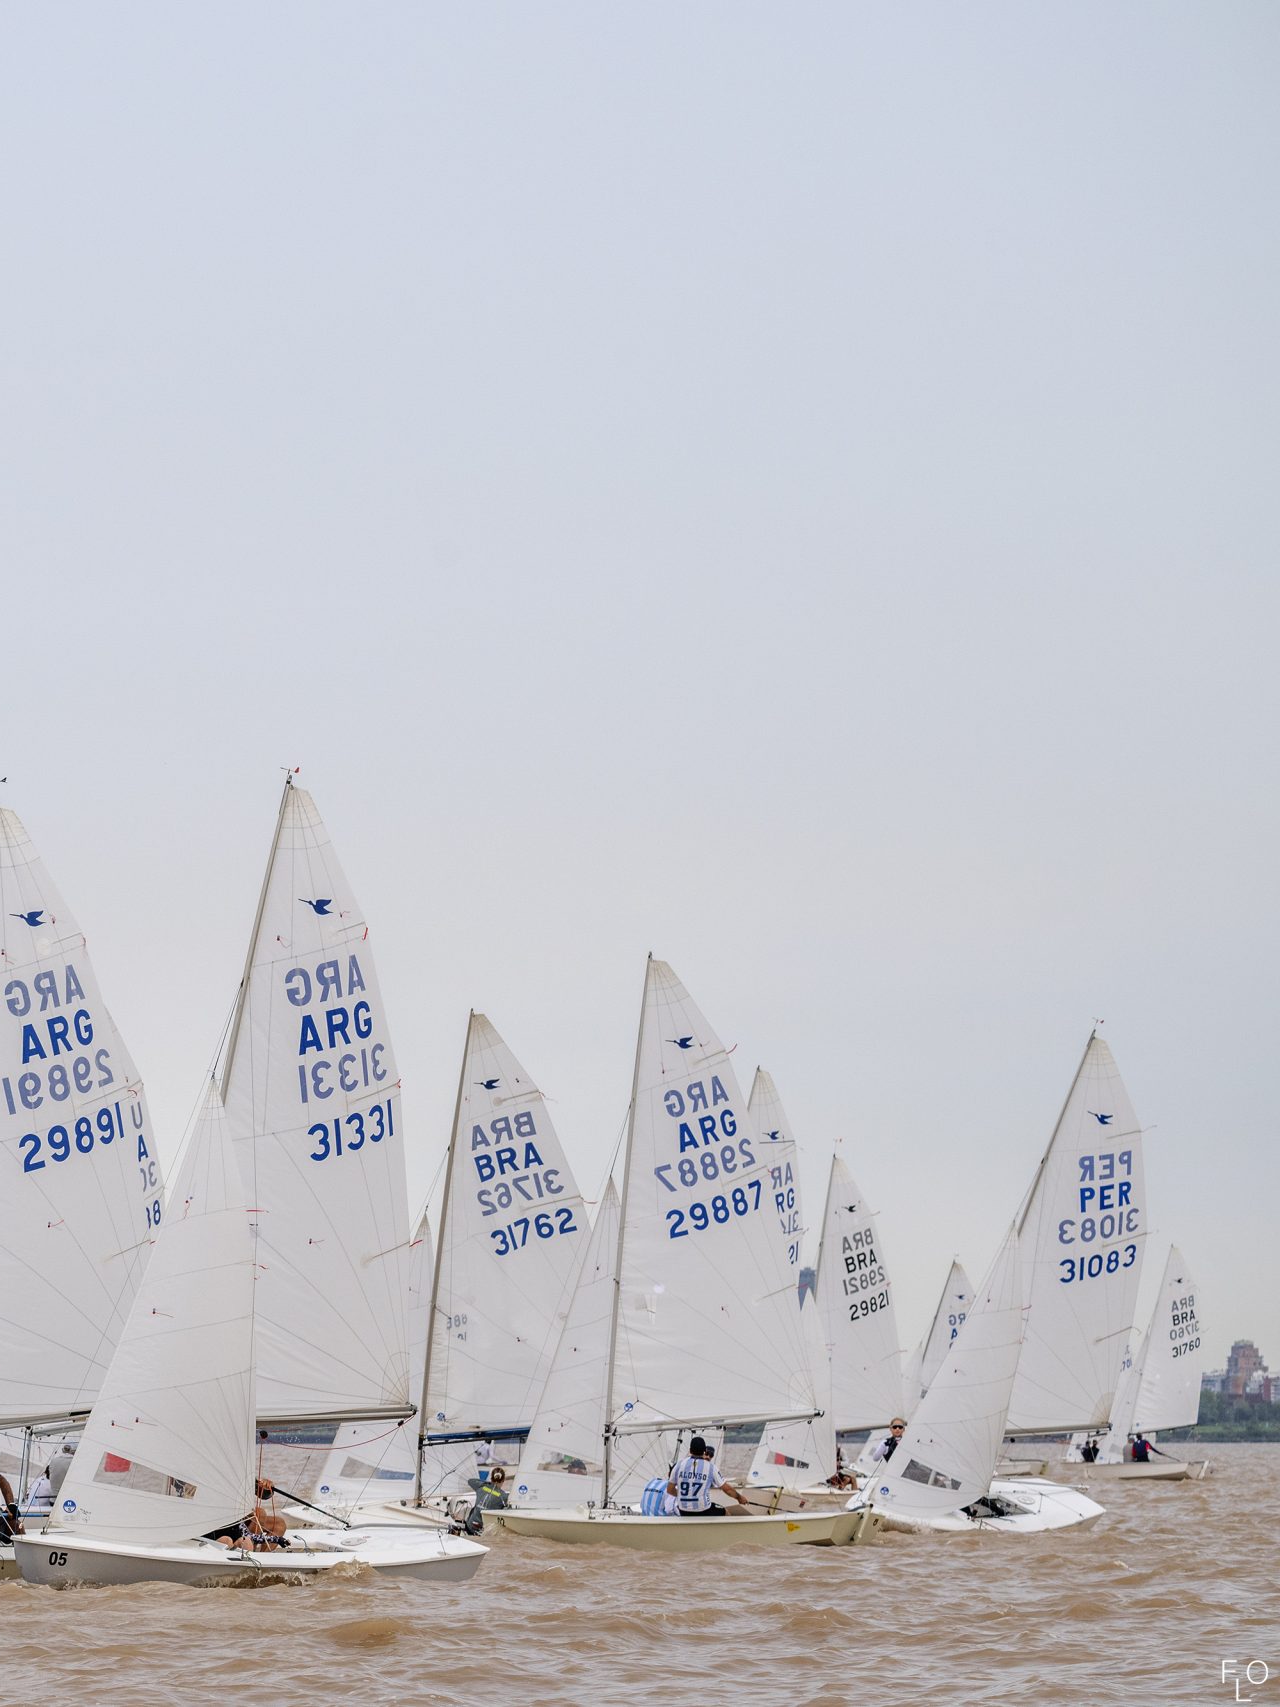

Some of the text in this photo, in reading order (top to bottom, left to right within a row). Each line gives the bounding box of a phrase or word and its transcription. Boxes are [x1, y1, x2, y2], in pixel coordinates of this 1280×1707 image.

[22, 1009, 93, 1064] ARG
[299, 1000, 373, 1056] ARG
[19, 1101, 124, 1173] 29891
[307, 1099, 394, 1162] 31331
[679, 1109, 737, 1153] ARG
[474, 1142, 544, 1183] BRA
[665, 1179, 762, 1239] 29887
[775, 1188, 795, 1213] RG
[1079, 1181, 1133, 1213] PER
[490, 1208, 577, 1256] 31762
[844, 1248, 878, 1274] BRA
[1059, 1244, 1137, 1283] 31083
[848, 1289, 890, 1321] 29821
[1172, 1309, 1196, 1326] BRA
[1172, 1337, 1201, 1358] 31760
[679, 1471, 707, 1480] ALONSO
[680, 1482, 704, 1496] 97
[48, 1551, 69, 1566] 05
